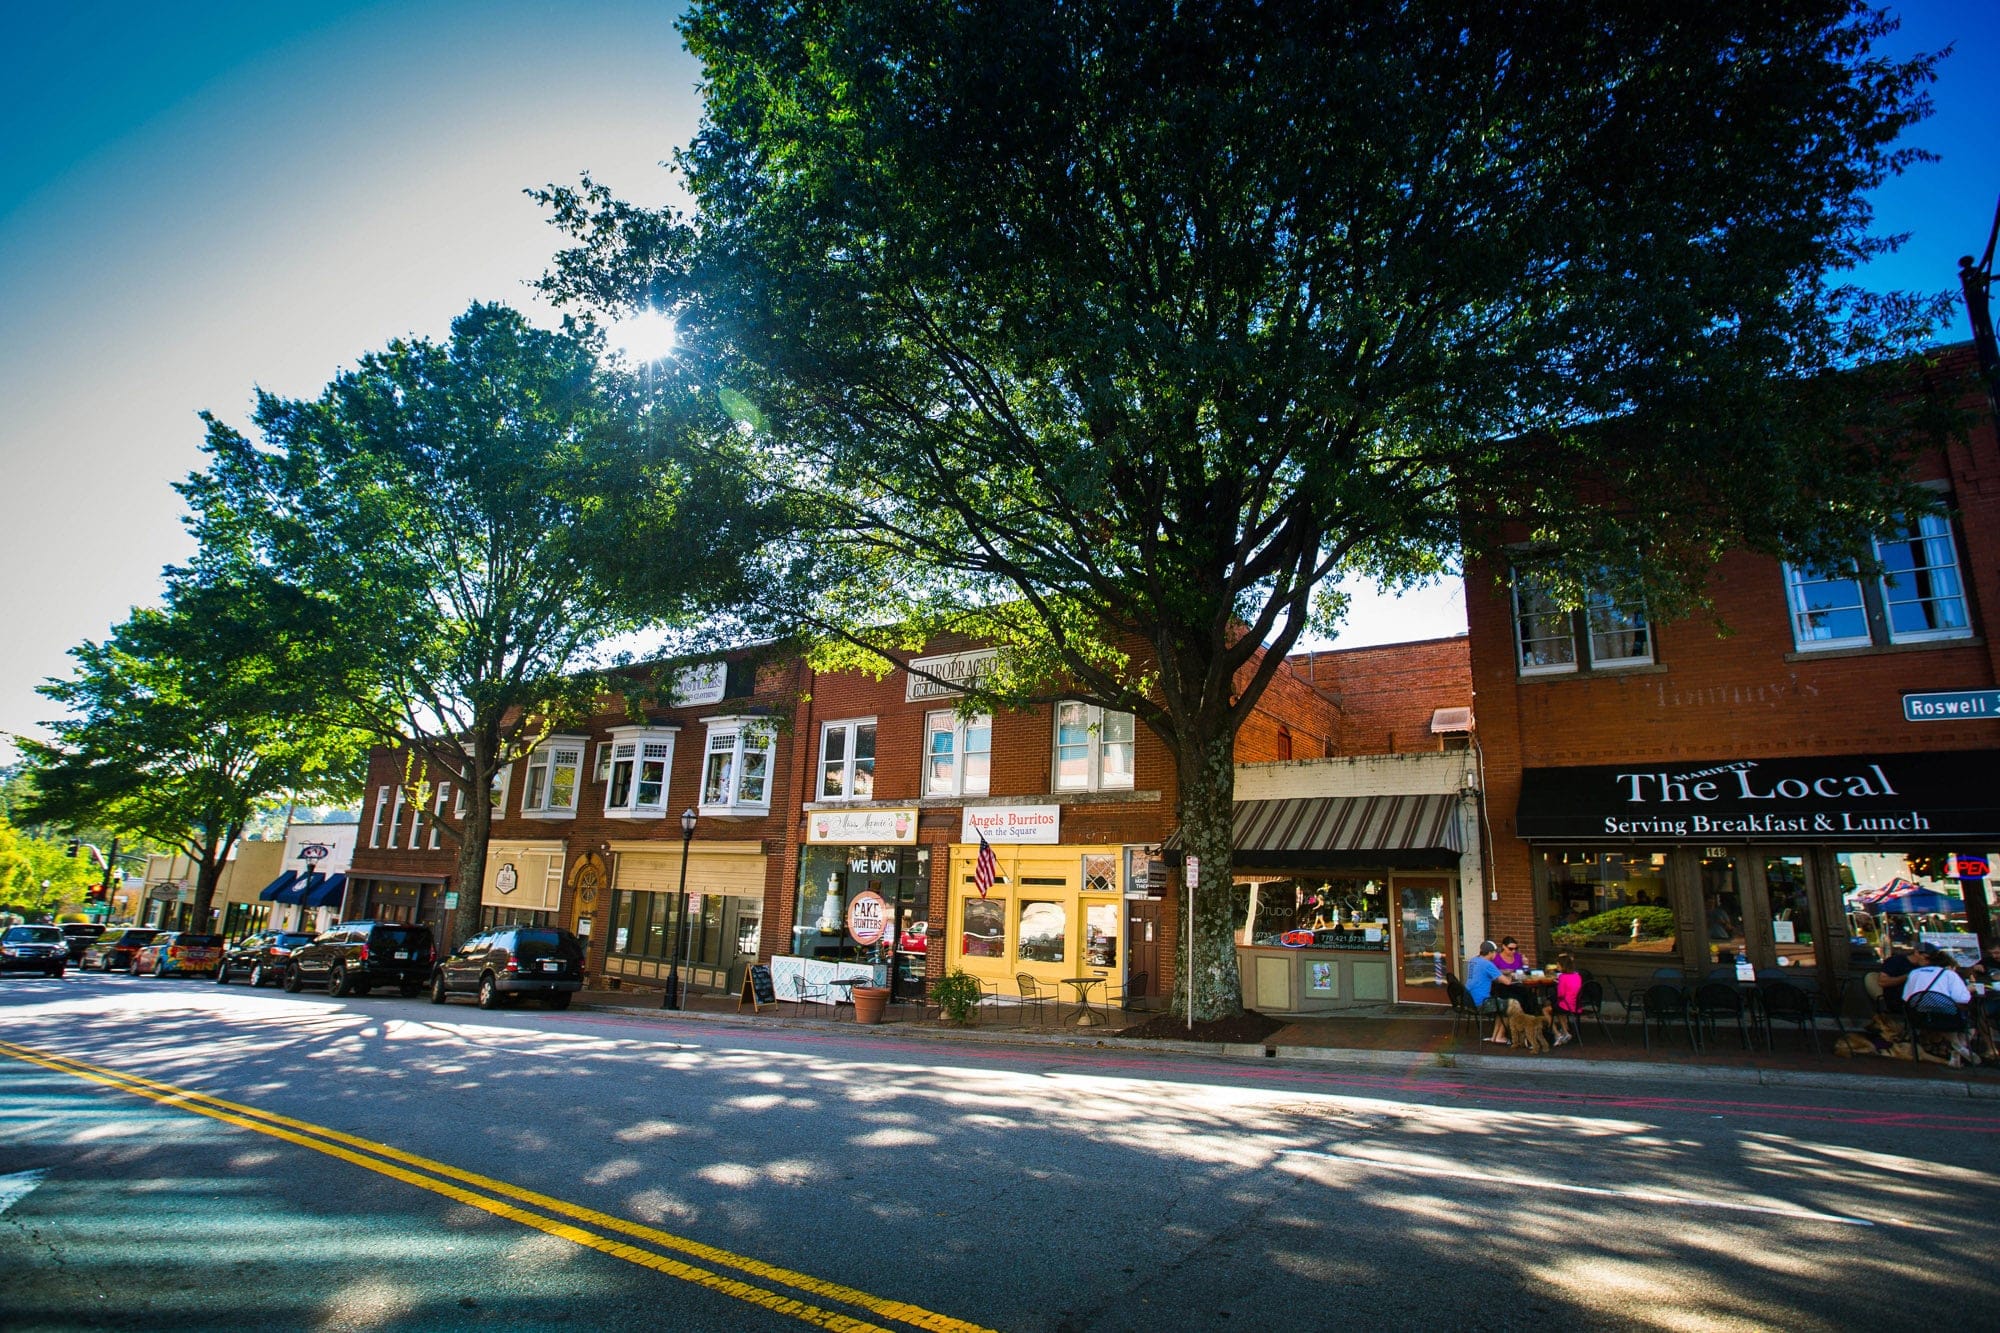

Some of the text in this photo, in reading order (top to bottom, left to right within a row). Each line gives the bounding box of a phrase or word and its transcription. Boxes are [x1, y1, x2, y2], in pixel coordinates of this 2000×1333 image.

[912, 655, 1001, 683] CHIROPRACTO
[1911, 698, 1986, 716] Roswell
[1673, 760, 1759, 783] MARIETTA
[1616, 764, 1899, 802] The Local
[968, 812, 1054, 829] Angels Burritos
[1604, 811, 1931, 836] Serving Breakfast & Lunch
[983, 826, 1037, 837] on the Square
[851, 859, 896, 874] WE WON
[854, 902, 880, 918] CAKE
[853, 918, 882, 929] HUNTERS
[1281, 932, 1315, 946] OPEN
